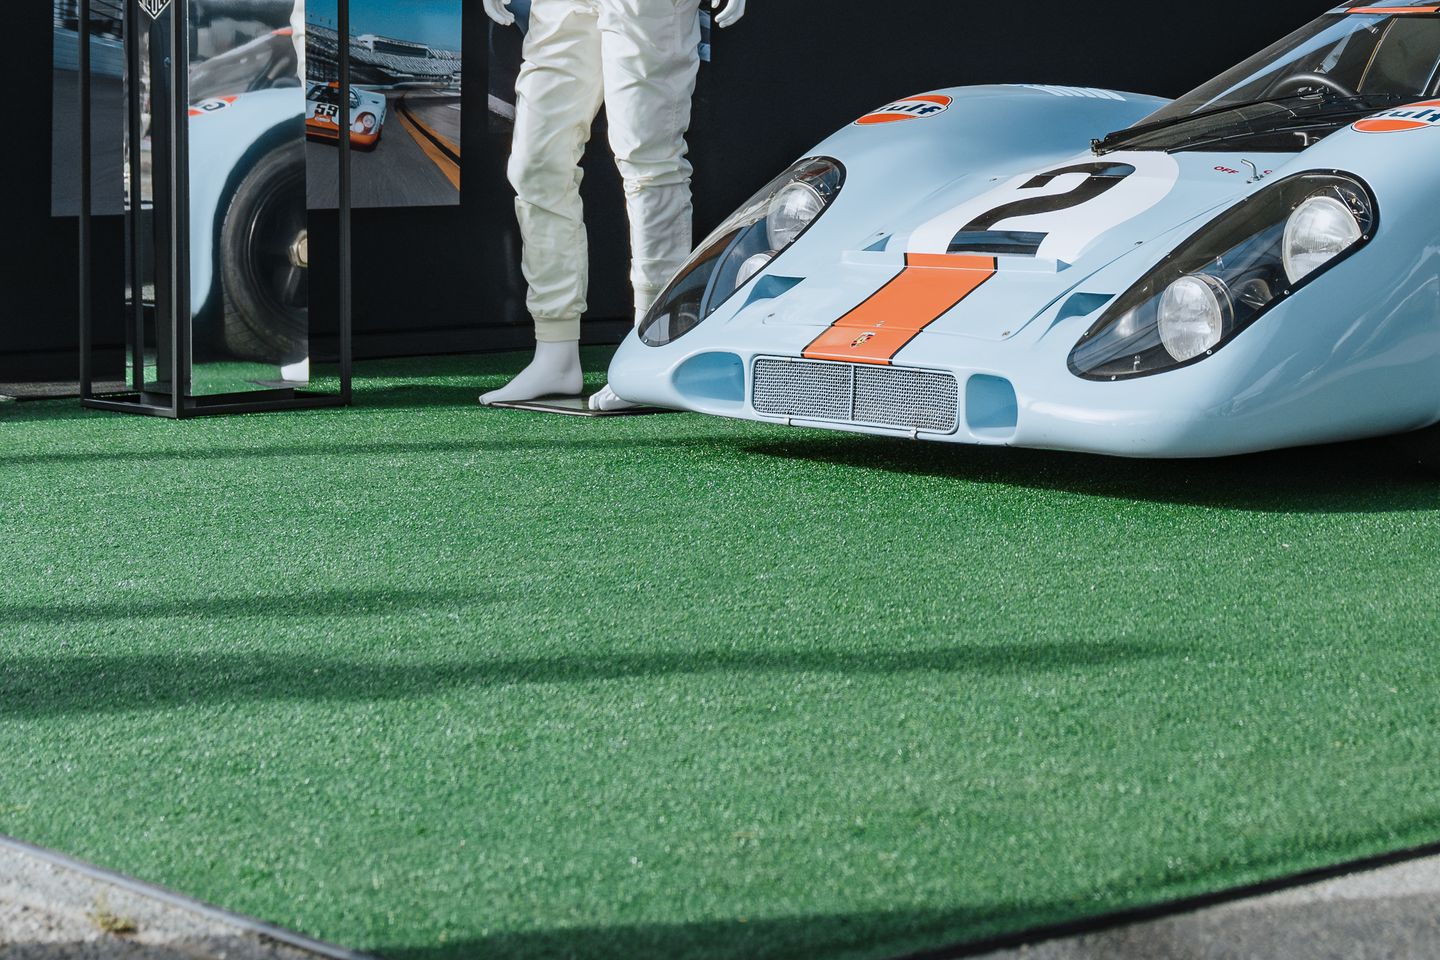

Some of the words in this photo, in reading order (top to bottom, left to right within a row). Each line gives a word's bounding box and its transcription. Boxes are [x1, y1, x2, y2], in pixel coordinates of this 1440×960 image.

[315, 103, 338, 117] 59
[1214, 166, 1239, 174] OFF
[946, 161, 1137, 258] 2
